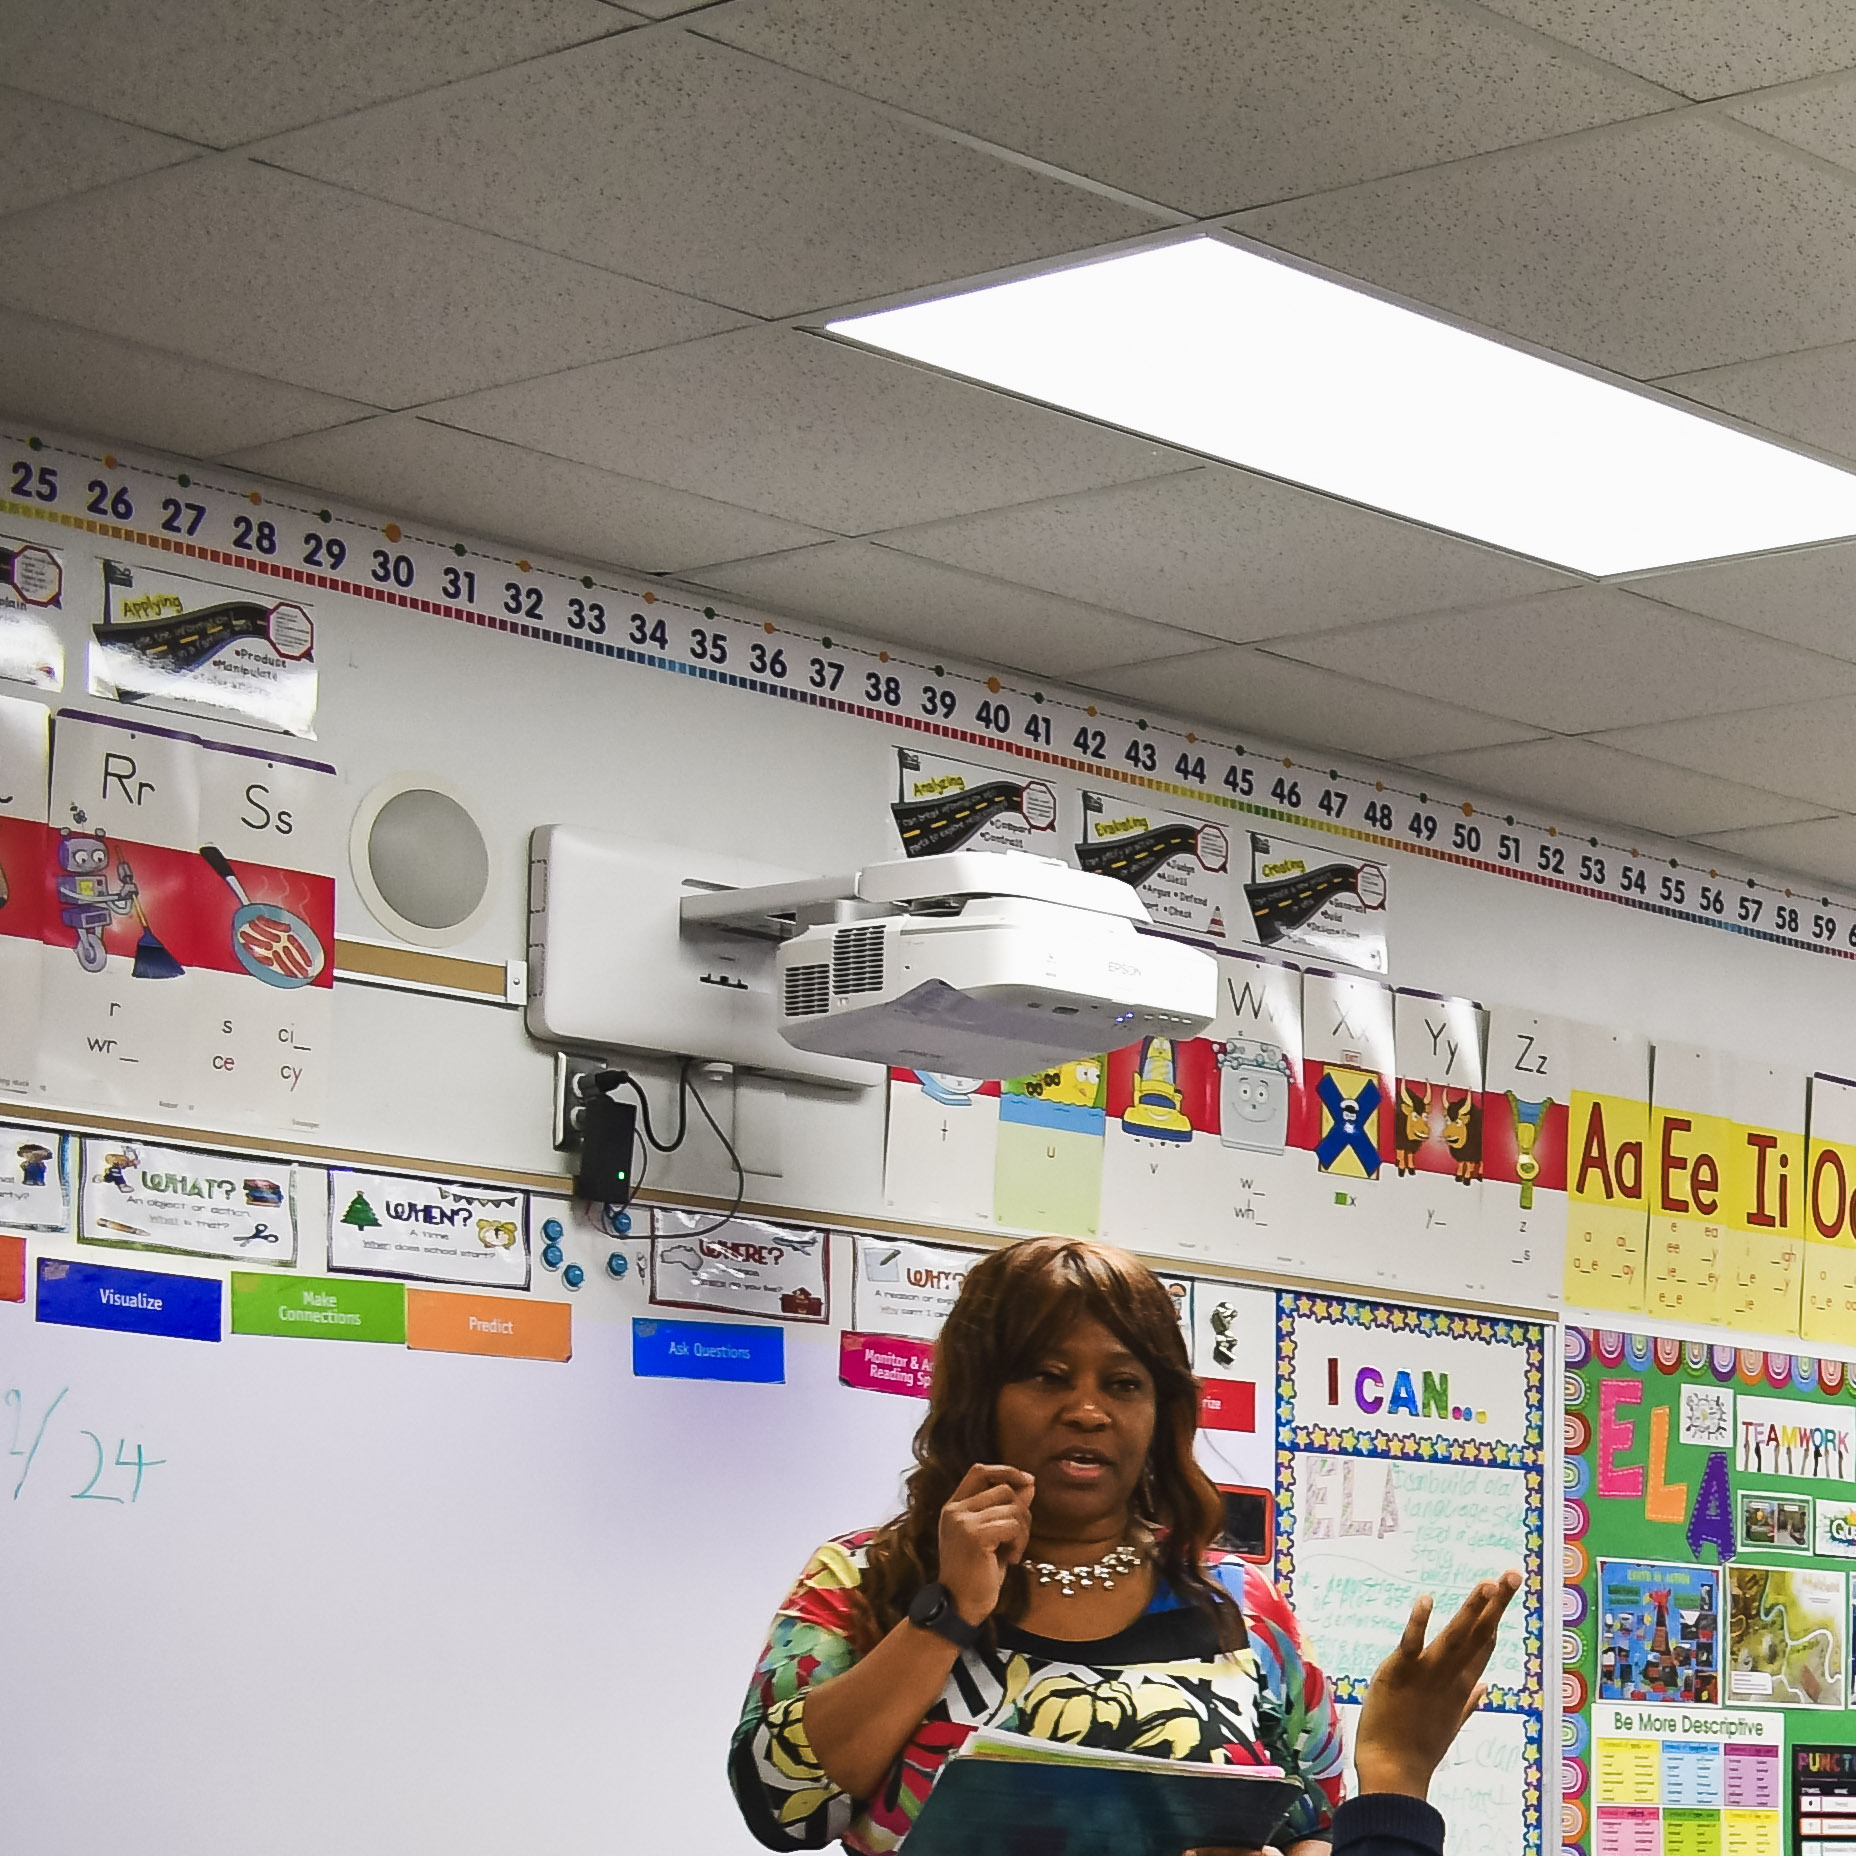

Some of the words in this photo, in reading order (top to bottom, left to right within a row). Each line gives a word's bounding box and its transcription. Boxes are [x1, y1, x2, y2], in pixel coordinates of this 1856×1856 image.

[123, 595, 184, 618] Applying
[241, 648, 287, 669] Produce
[10, 461, 58, 503] 25
[302, 532, 347, 571] 29
[567, 597, 607, 635] 33
[809, 657, 845, 692] 37
[1023, 713, 1052, 746] 41
[1223, 765, 1254, 797] 45
[1407, 811, 1438, 842] 49
[1579, 855, 1606, 885] 53
[1737, 895, 1764, 923] 57
[103, 752, 155, 806] Rr
[240, 784, 293, 834] Ss
[1424, 1018, 1459, 1075] Yy
[1514, 1034, 1548, 1075] Zz
[1576, 1102, 1643, 1200] Aa
[1661, 1115, 1719, 1216] Ee
[141, 1170, 237, 1200] WHAT?
[1746, 1132, 1789, 1228] Ii
[386, 1199, 473, 1227] WHEN?
[699, 1238, 784, 1267] WHERE?
[99, 1288, 163, 1311] Visualize
[303, 1291, 337, 1308] Make
[279, 1306, 361, 1326] Connections
[469, 1316, 514, 1335] Predict
[669, 1342, 690, 1358] Ask
[693, 1343, 751, 1361] Questions
[864, 1349, 906, 1369] Monitor
[870, 1365, 913, 1387] Reading
[1328, 1358, 1338, 1406] I
[1742, 1420, 1849, 1454] TEAMWORK
[1614, 1712, 1633, 1731] Be
[1638, 1713, 1677, 1733] More
[1682, 1715, 1764, 1739] Descriptive
